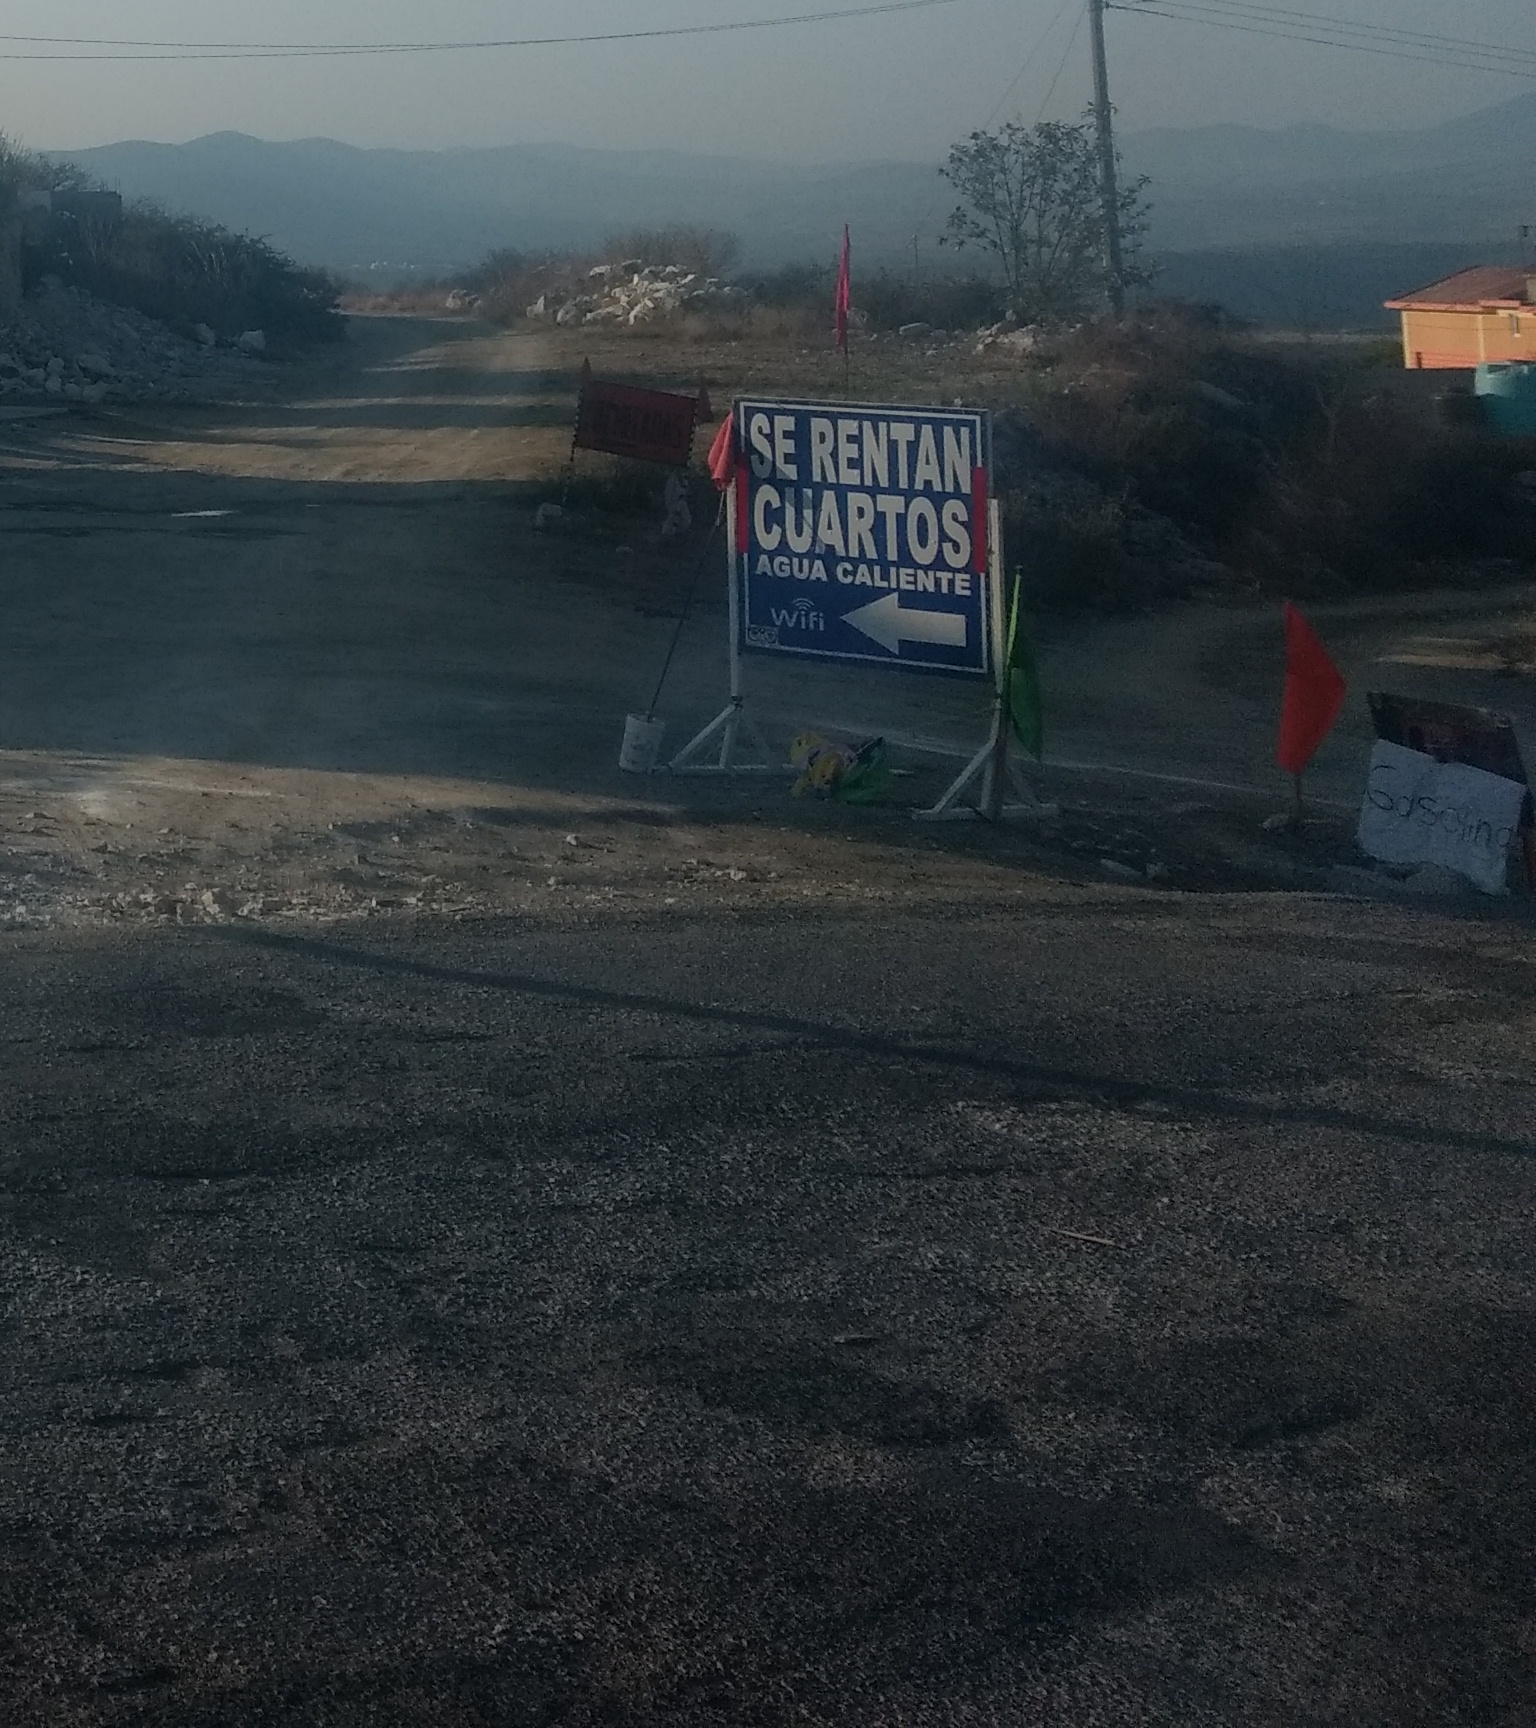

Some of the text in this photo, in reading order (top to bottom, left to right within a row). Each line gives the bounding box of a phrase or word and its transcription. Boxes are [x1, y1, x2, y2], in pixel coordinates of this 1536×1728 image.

[748, 411, 799, 481] SE
[809, 415, 973, 496] RENTAN
[752, 483, 972, 570] CUARTOS
[753, 554, 973, 598] AGUA CALIENTE
[769, 605, 825, 632] Wifi
